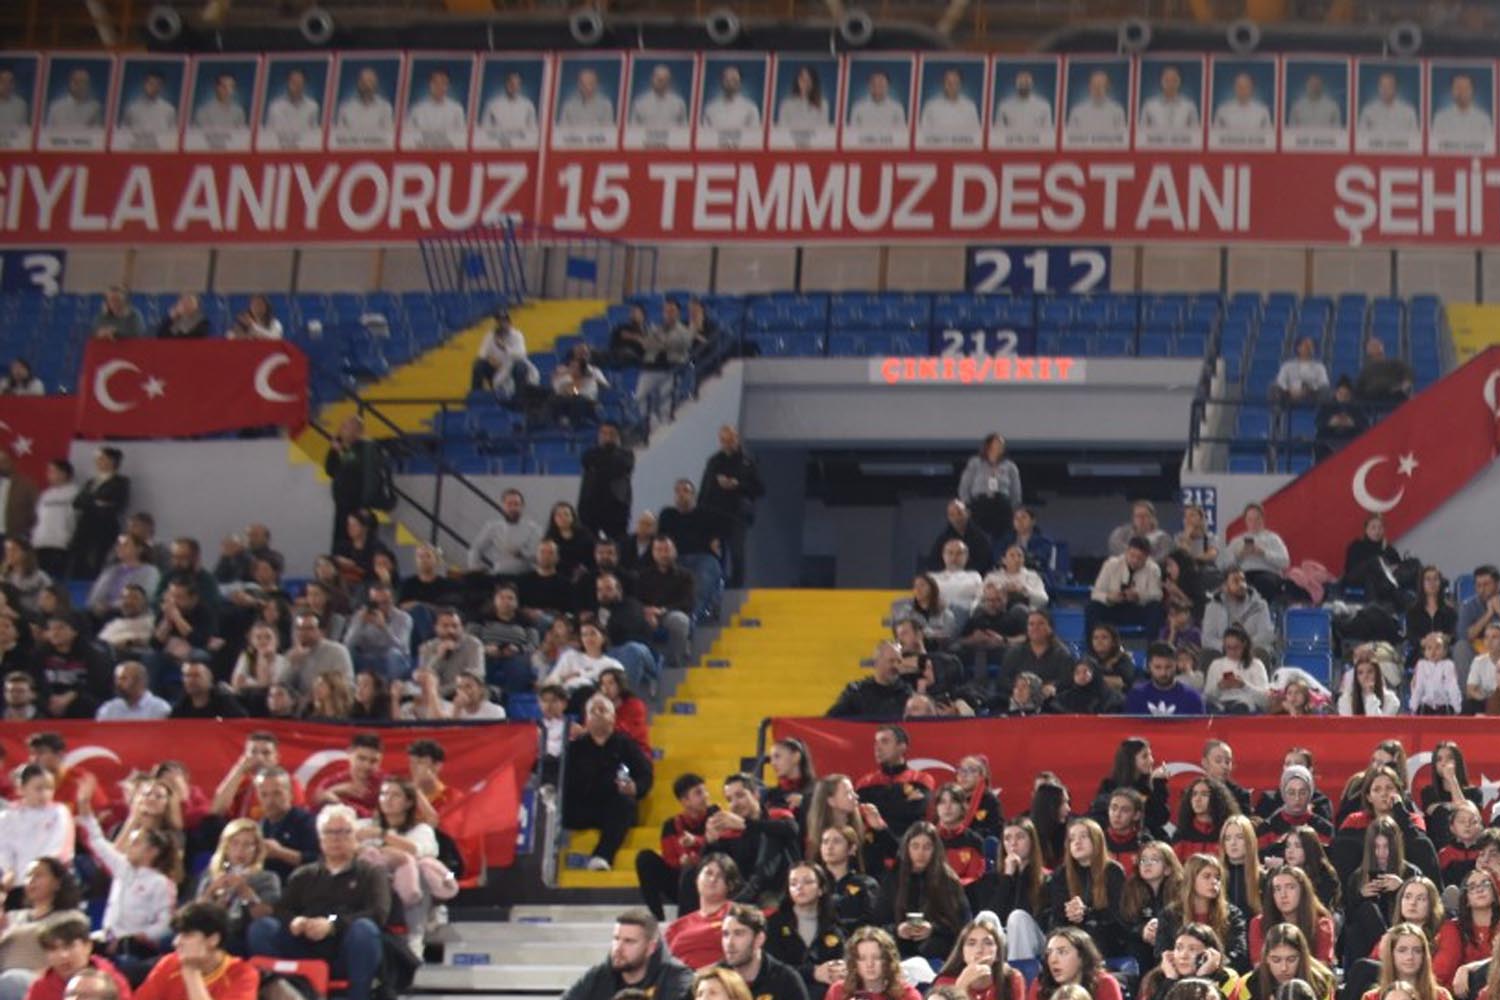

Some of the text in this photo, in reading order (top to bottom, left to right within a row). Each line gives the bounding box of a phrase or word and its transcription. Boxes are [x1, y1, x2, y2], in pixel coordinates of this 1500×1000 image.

[0, 161, 528, 231] IYLA ANIYORUZ
[552, 163, 630, 231] 15
[648, 163, 938, 231] TEMMUZ
[950, 162, 1251, 232] DESTANI
[973, 250, 1107, 294] 212
[941, 329, 1019, 358] 212
[1183, 489, 1215, 505] 212
